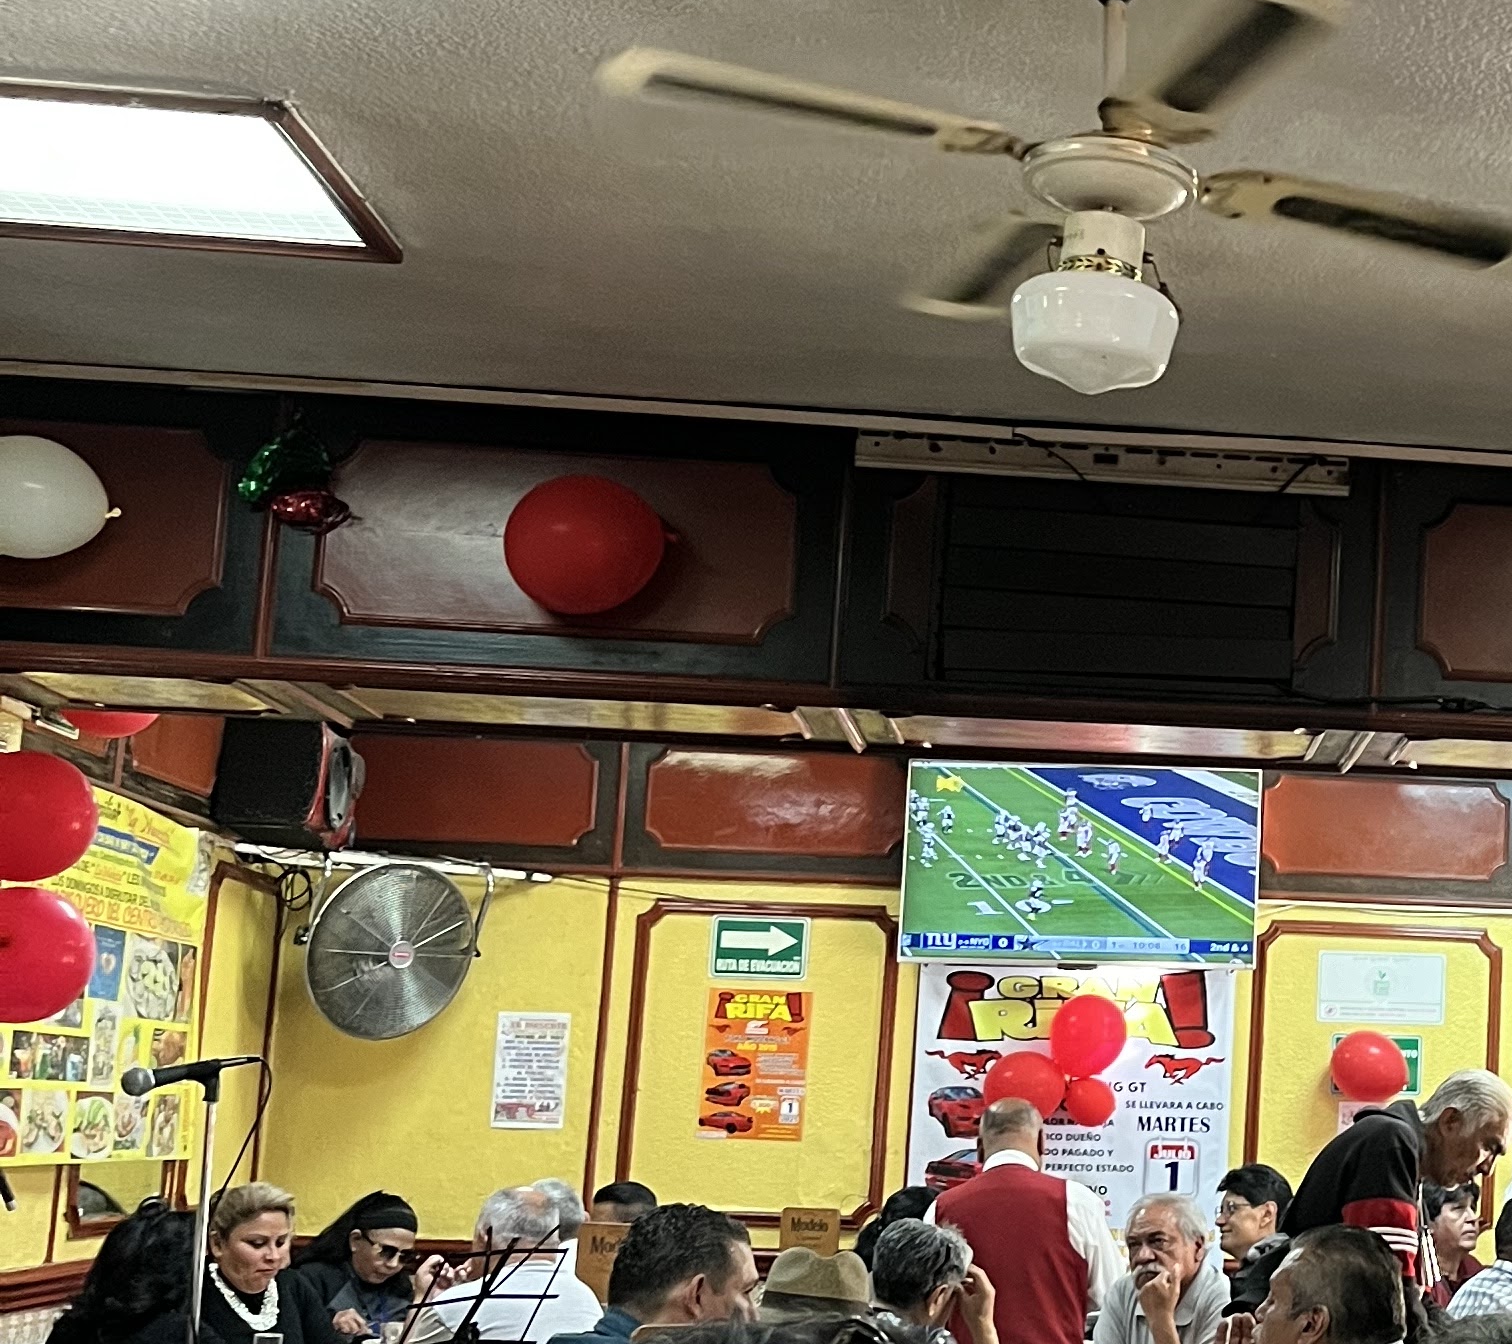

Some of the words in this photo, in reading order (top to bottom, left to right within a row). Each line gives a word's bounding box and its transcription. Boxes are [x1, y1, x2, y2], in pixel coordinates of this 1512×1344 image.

[1125, 1100, 1138, 1110] SE
[1139, 1100, 1184, 1110] LLEVARA
[1196, 1101, 1224, 1111] CABO
[1137, 1116, 1211, 1133] MARTES
[1065, 1131, 1101, 1142] DUEÑO
[1061, 1148, 1104, 1158] PAGADO
[1045, 1163, 1094, 1173] PERFECTO
[1096, 1163, 1134, 1173] ESTADO
[1164, 1161, 1179, 1192] 1
